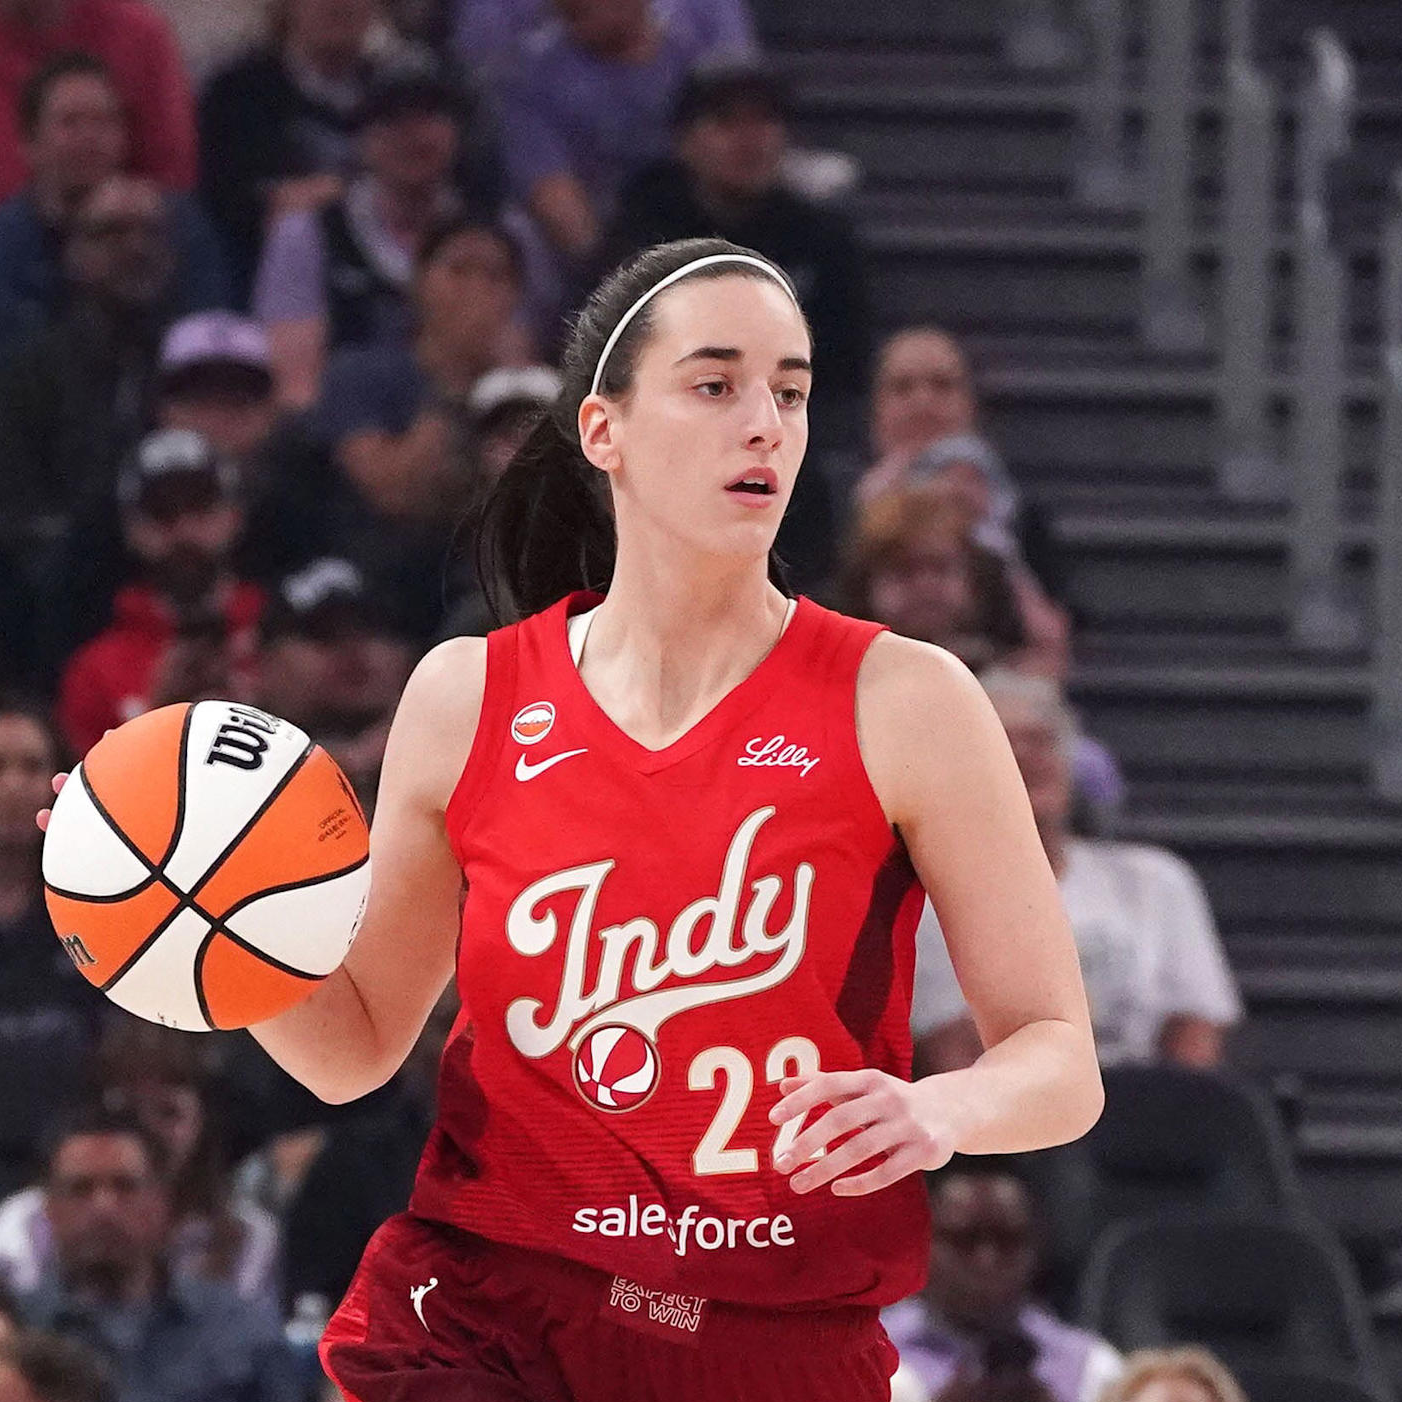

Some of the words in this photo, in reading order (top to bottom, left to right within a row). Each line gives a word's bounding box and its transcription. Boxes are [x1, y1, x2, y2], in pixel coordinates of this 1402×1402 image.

[205, 706, 281, 771] Wil
[737, 734, 820, 777] Lilly
[505, 804, 816, 1060] Indy
[609, 1286, 641, 1312] TO
[648, 1300, 701, 1332] WIN
